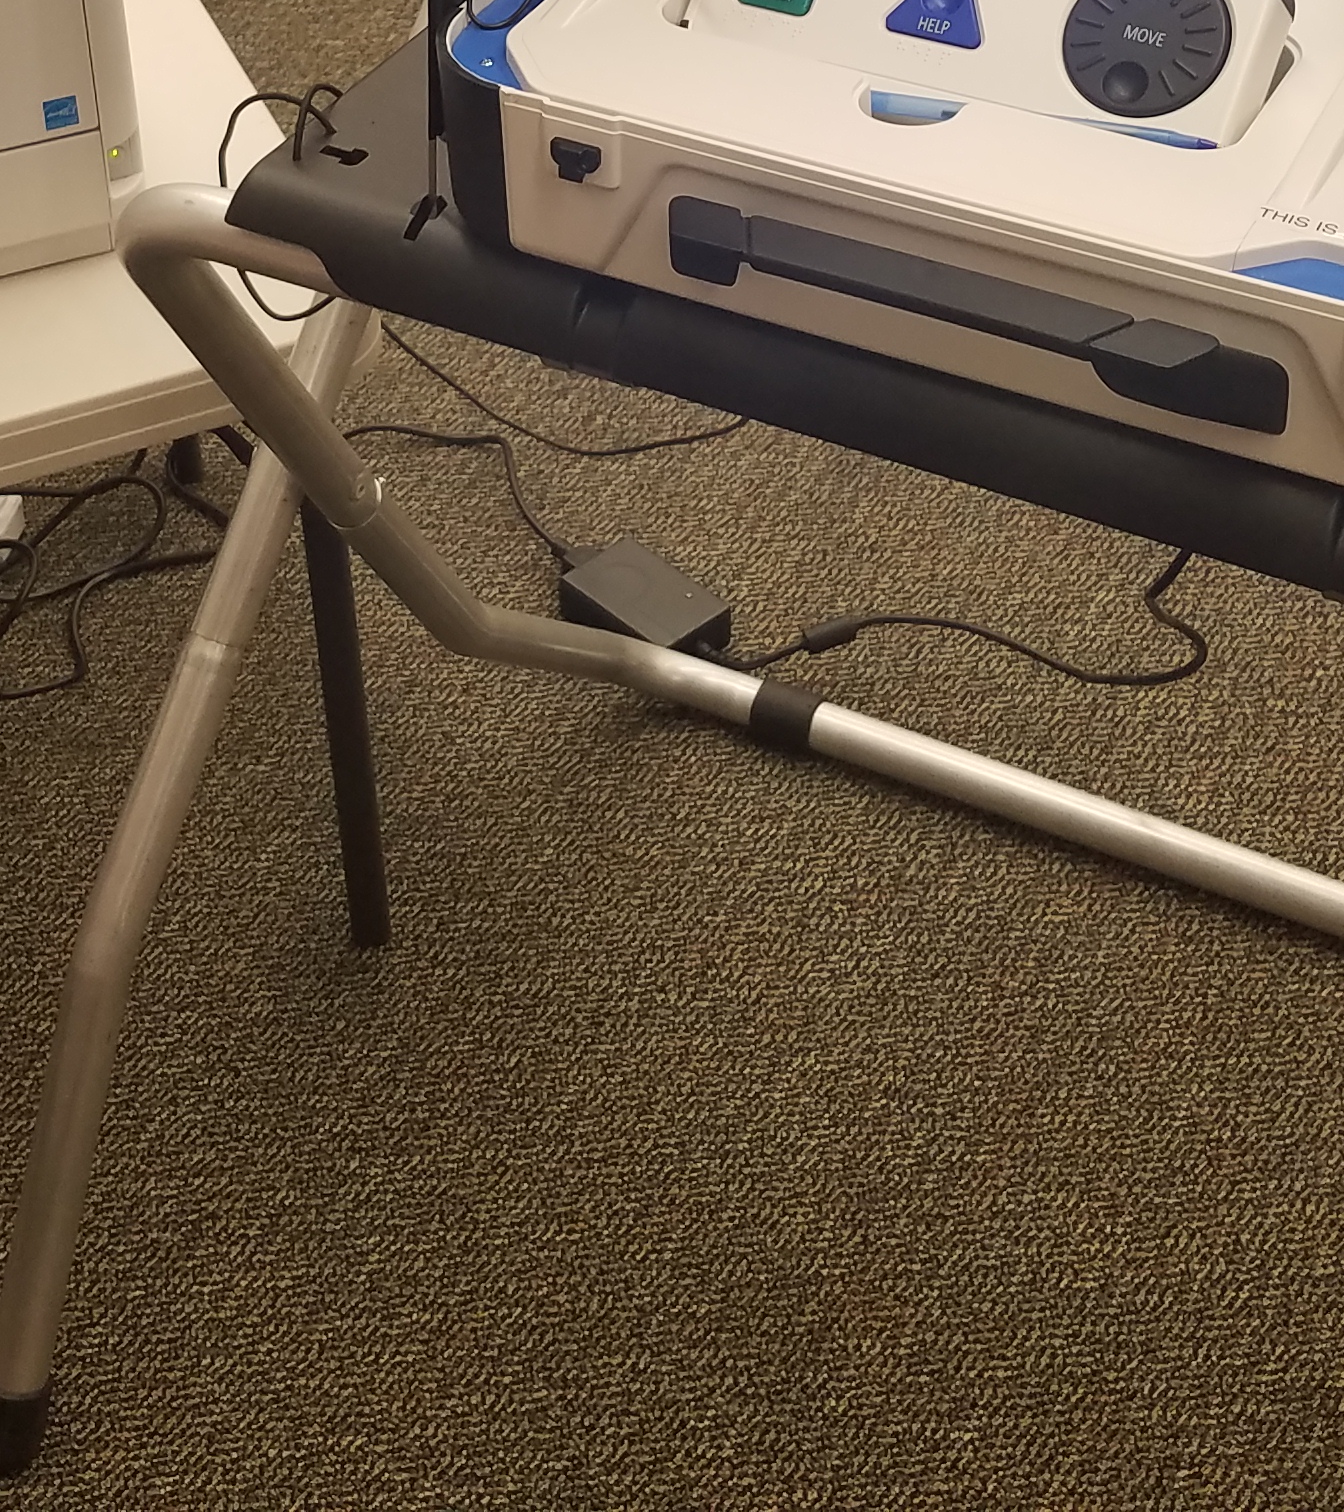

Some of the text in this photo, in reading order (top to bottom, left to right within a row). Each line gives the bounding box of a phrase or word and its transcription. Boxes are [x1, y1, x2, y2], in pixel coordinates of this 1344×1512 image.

[917, 16, 951, 35] HELP
[1123, 24, 1167, 48] MOVE
[1260, 206, 1309, 229] THIS
[1316, 221, 1338, 236] IS
